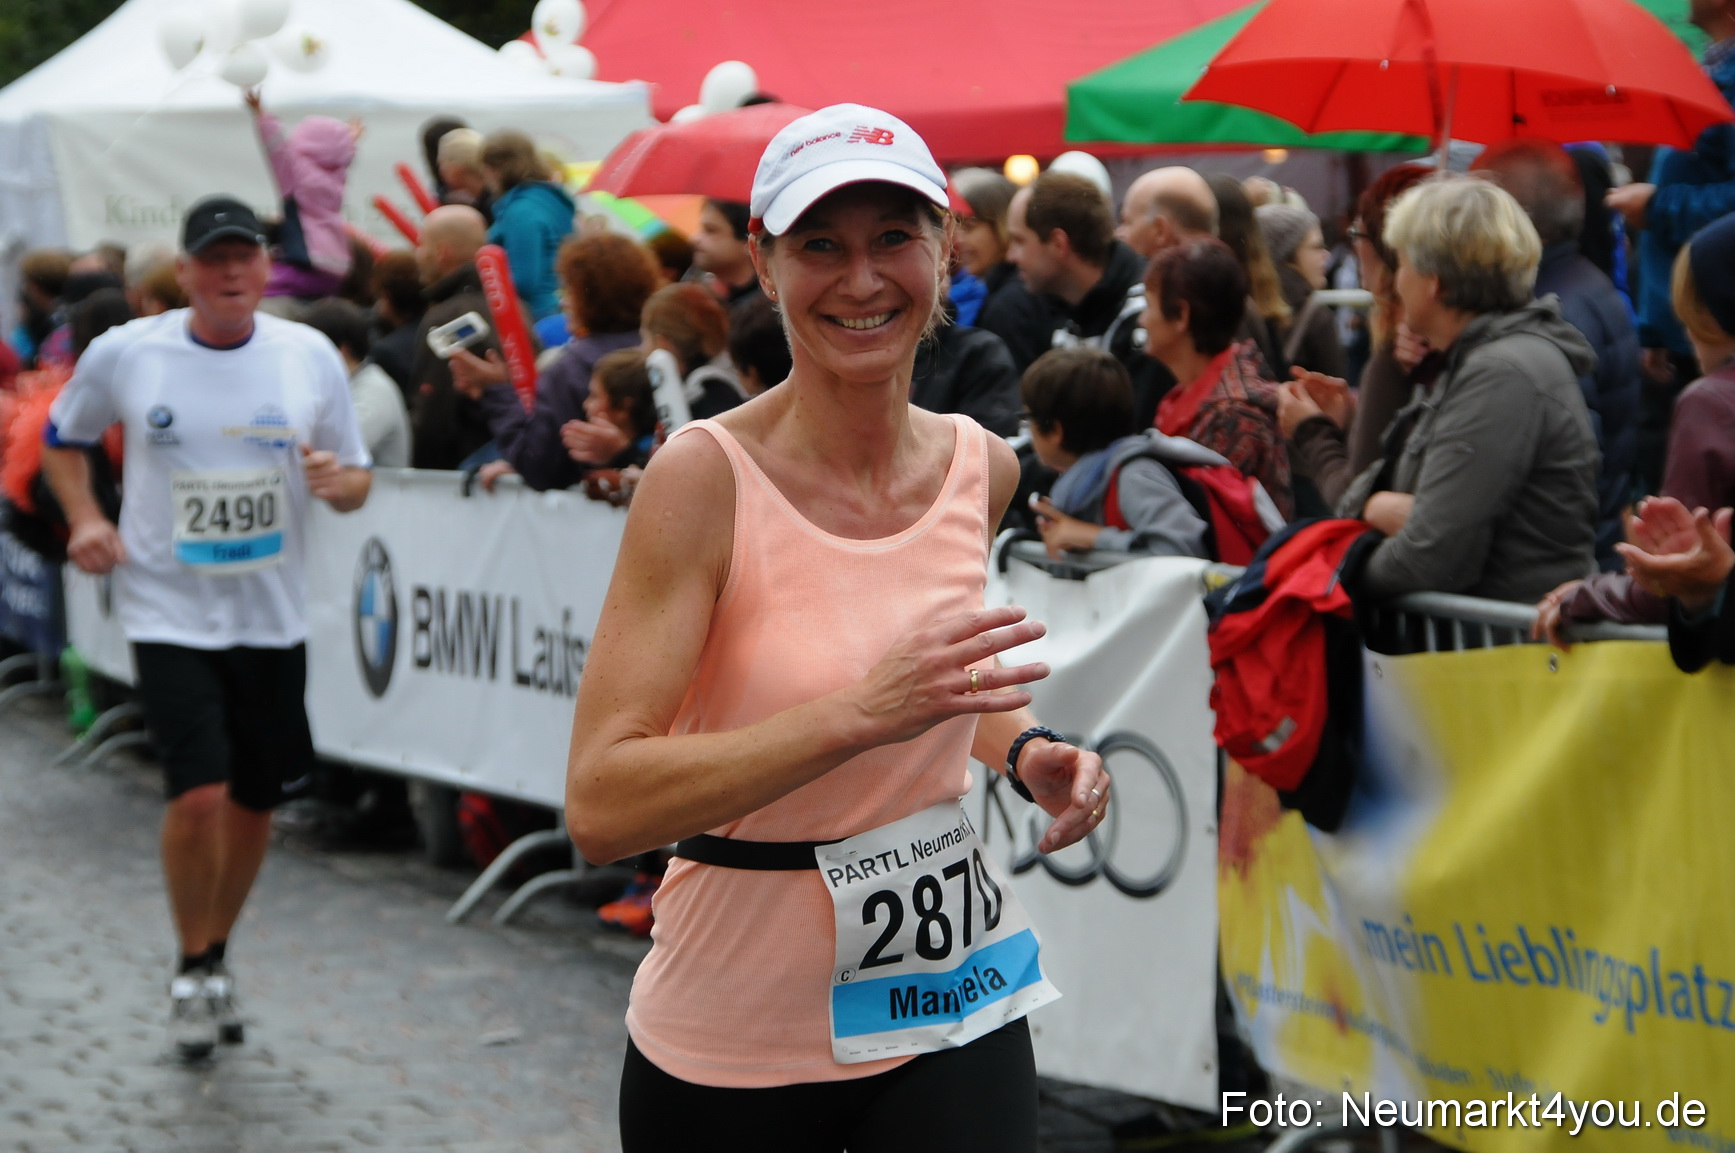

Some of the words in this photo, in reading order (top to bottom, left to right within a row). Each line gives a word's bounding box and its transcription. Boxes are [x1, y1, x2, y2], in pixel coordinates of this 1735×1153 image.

[790, 144, 805, 157] new
[805, 131, 842, 147] balance
[184, 491, 275, 534] 2490
[411, 584, 501, 682] BMW
[827, 848, 910, 888] PARTL
[859, 848, 1002, 970] 2870
[1363, 913, 1452, 977] mein
[1453, 920, 1735, 1035] Lieblingsplatz
